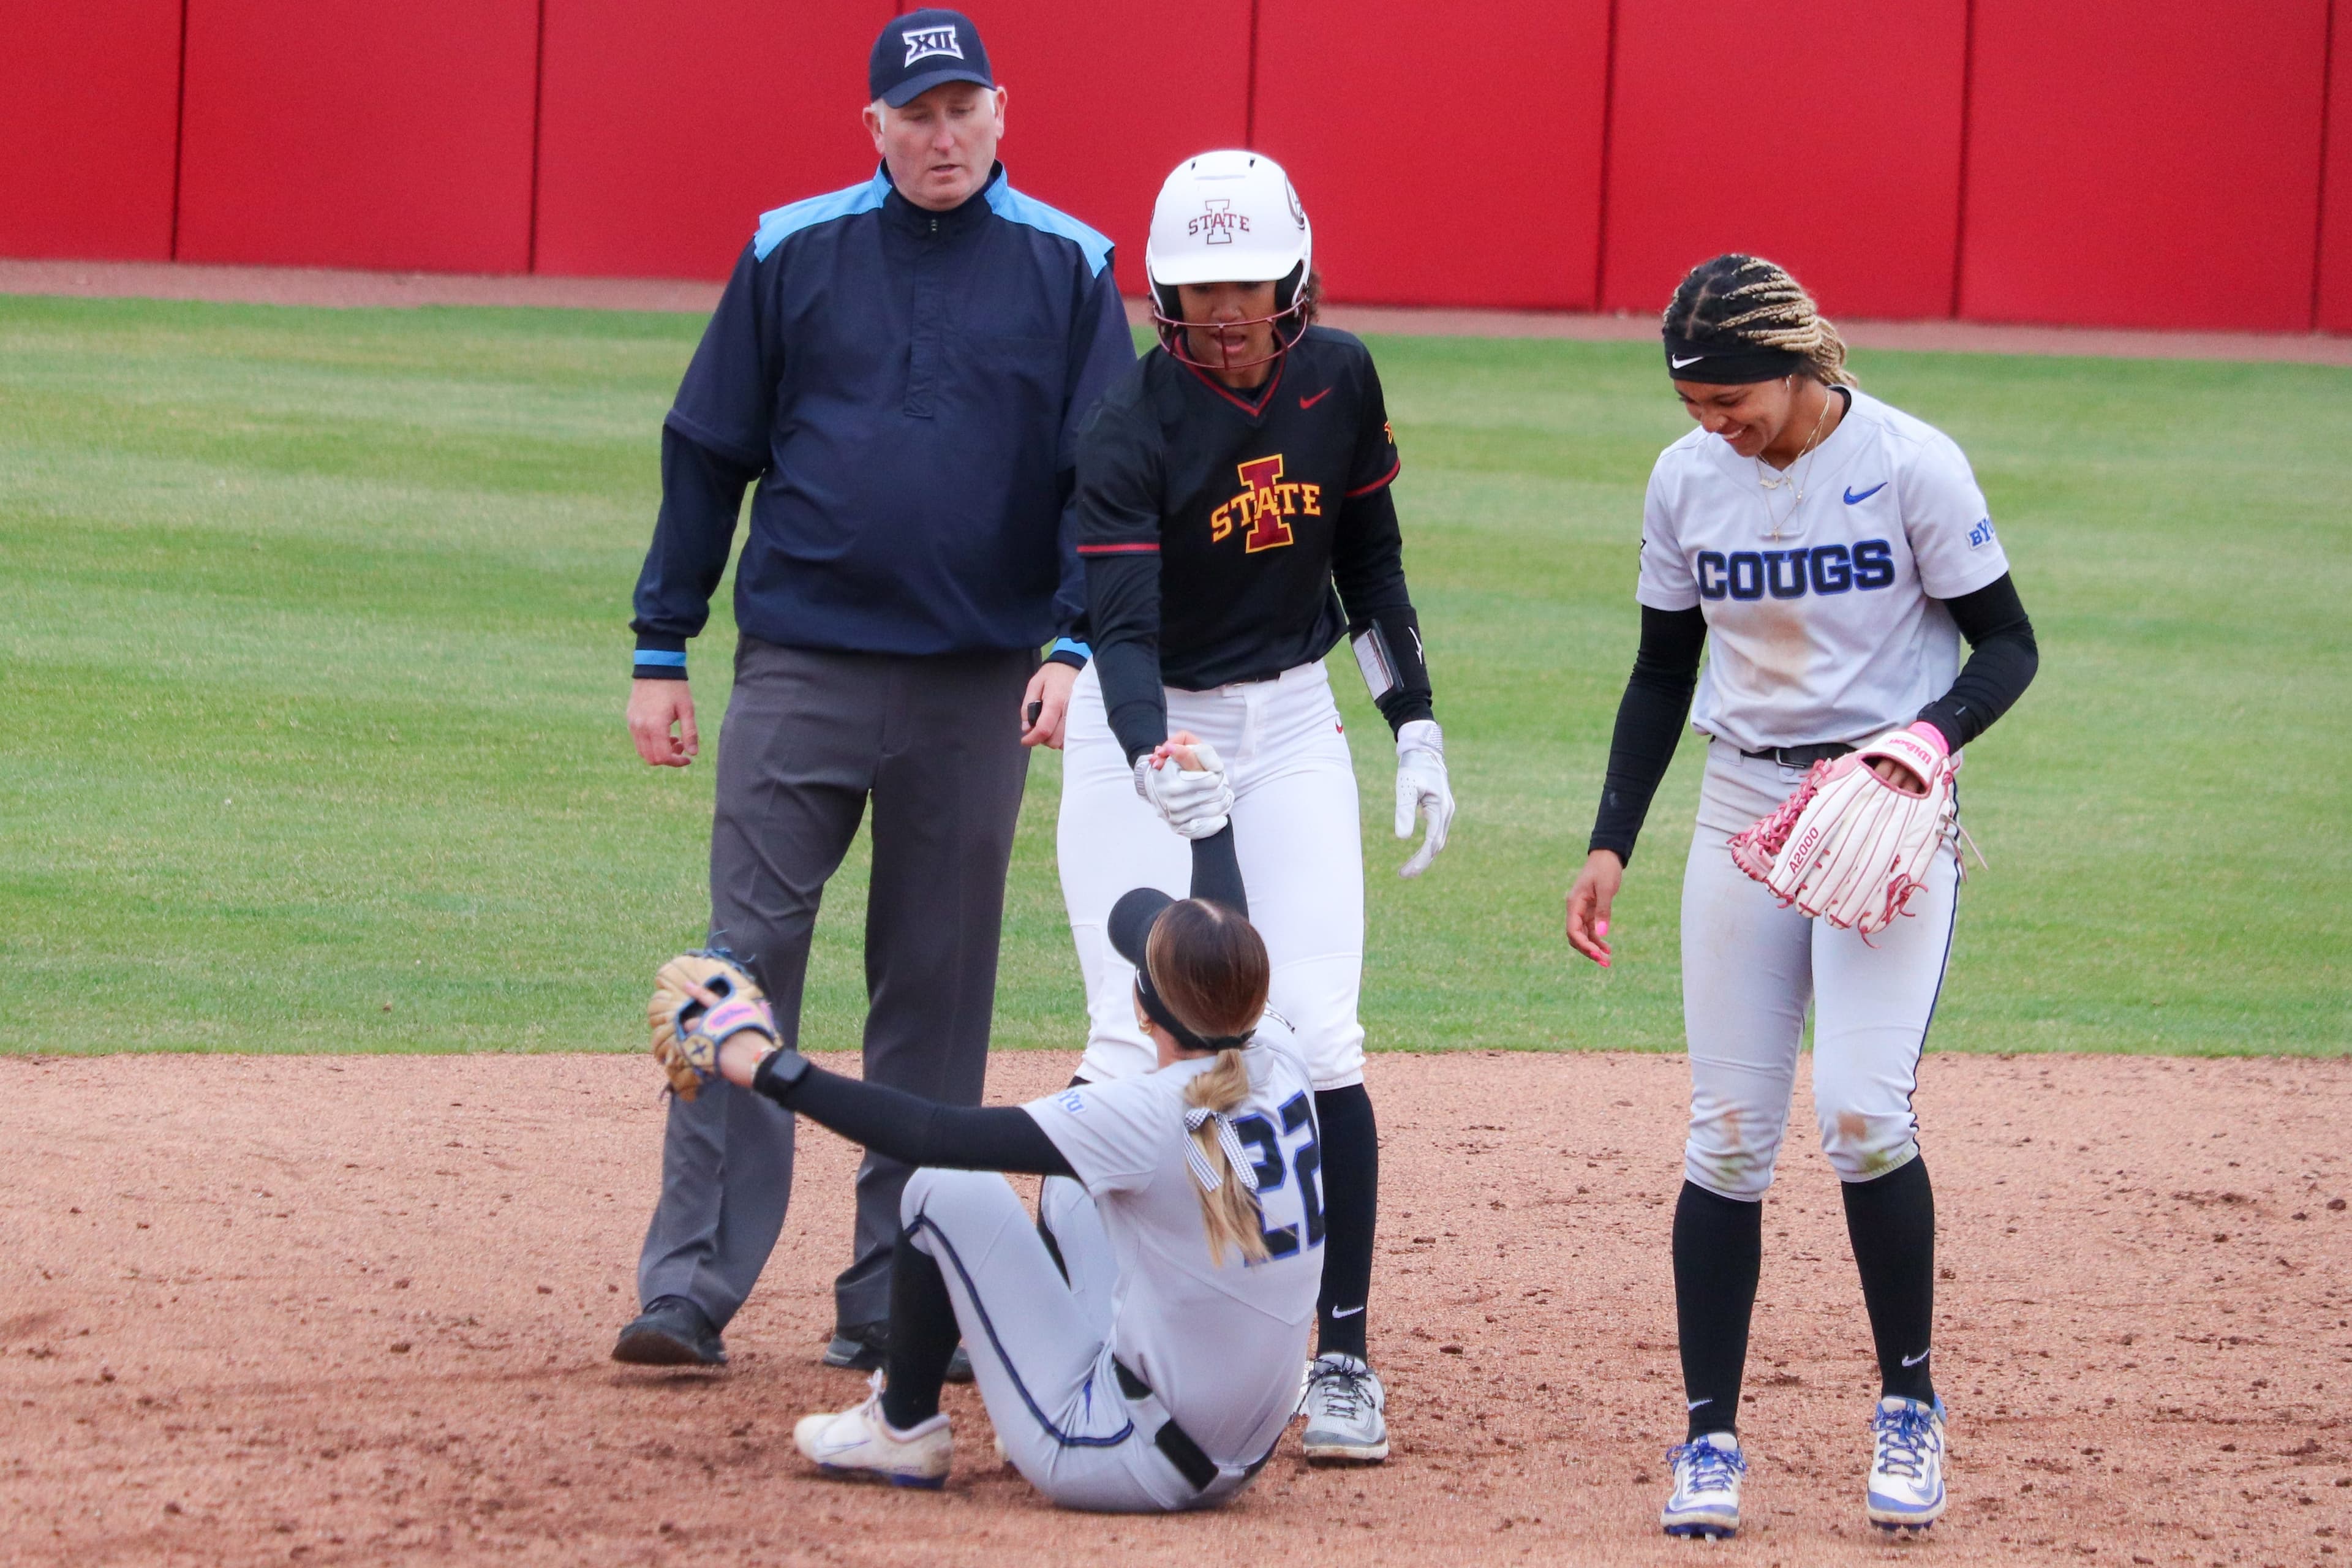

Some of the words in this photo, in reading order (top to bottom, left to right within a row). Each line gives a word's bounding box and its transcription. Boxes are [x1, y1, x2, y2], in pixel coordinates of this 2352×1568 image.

[1188, 213, 1250, 235] STATE
[1210, 482, 1321, 543] STATE
[1697, 539, 1894, 601] COUGS
[1789, 827, 1819, 874] A2000
